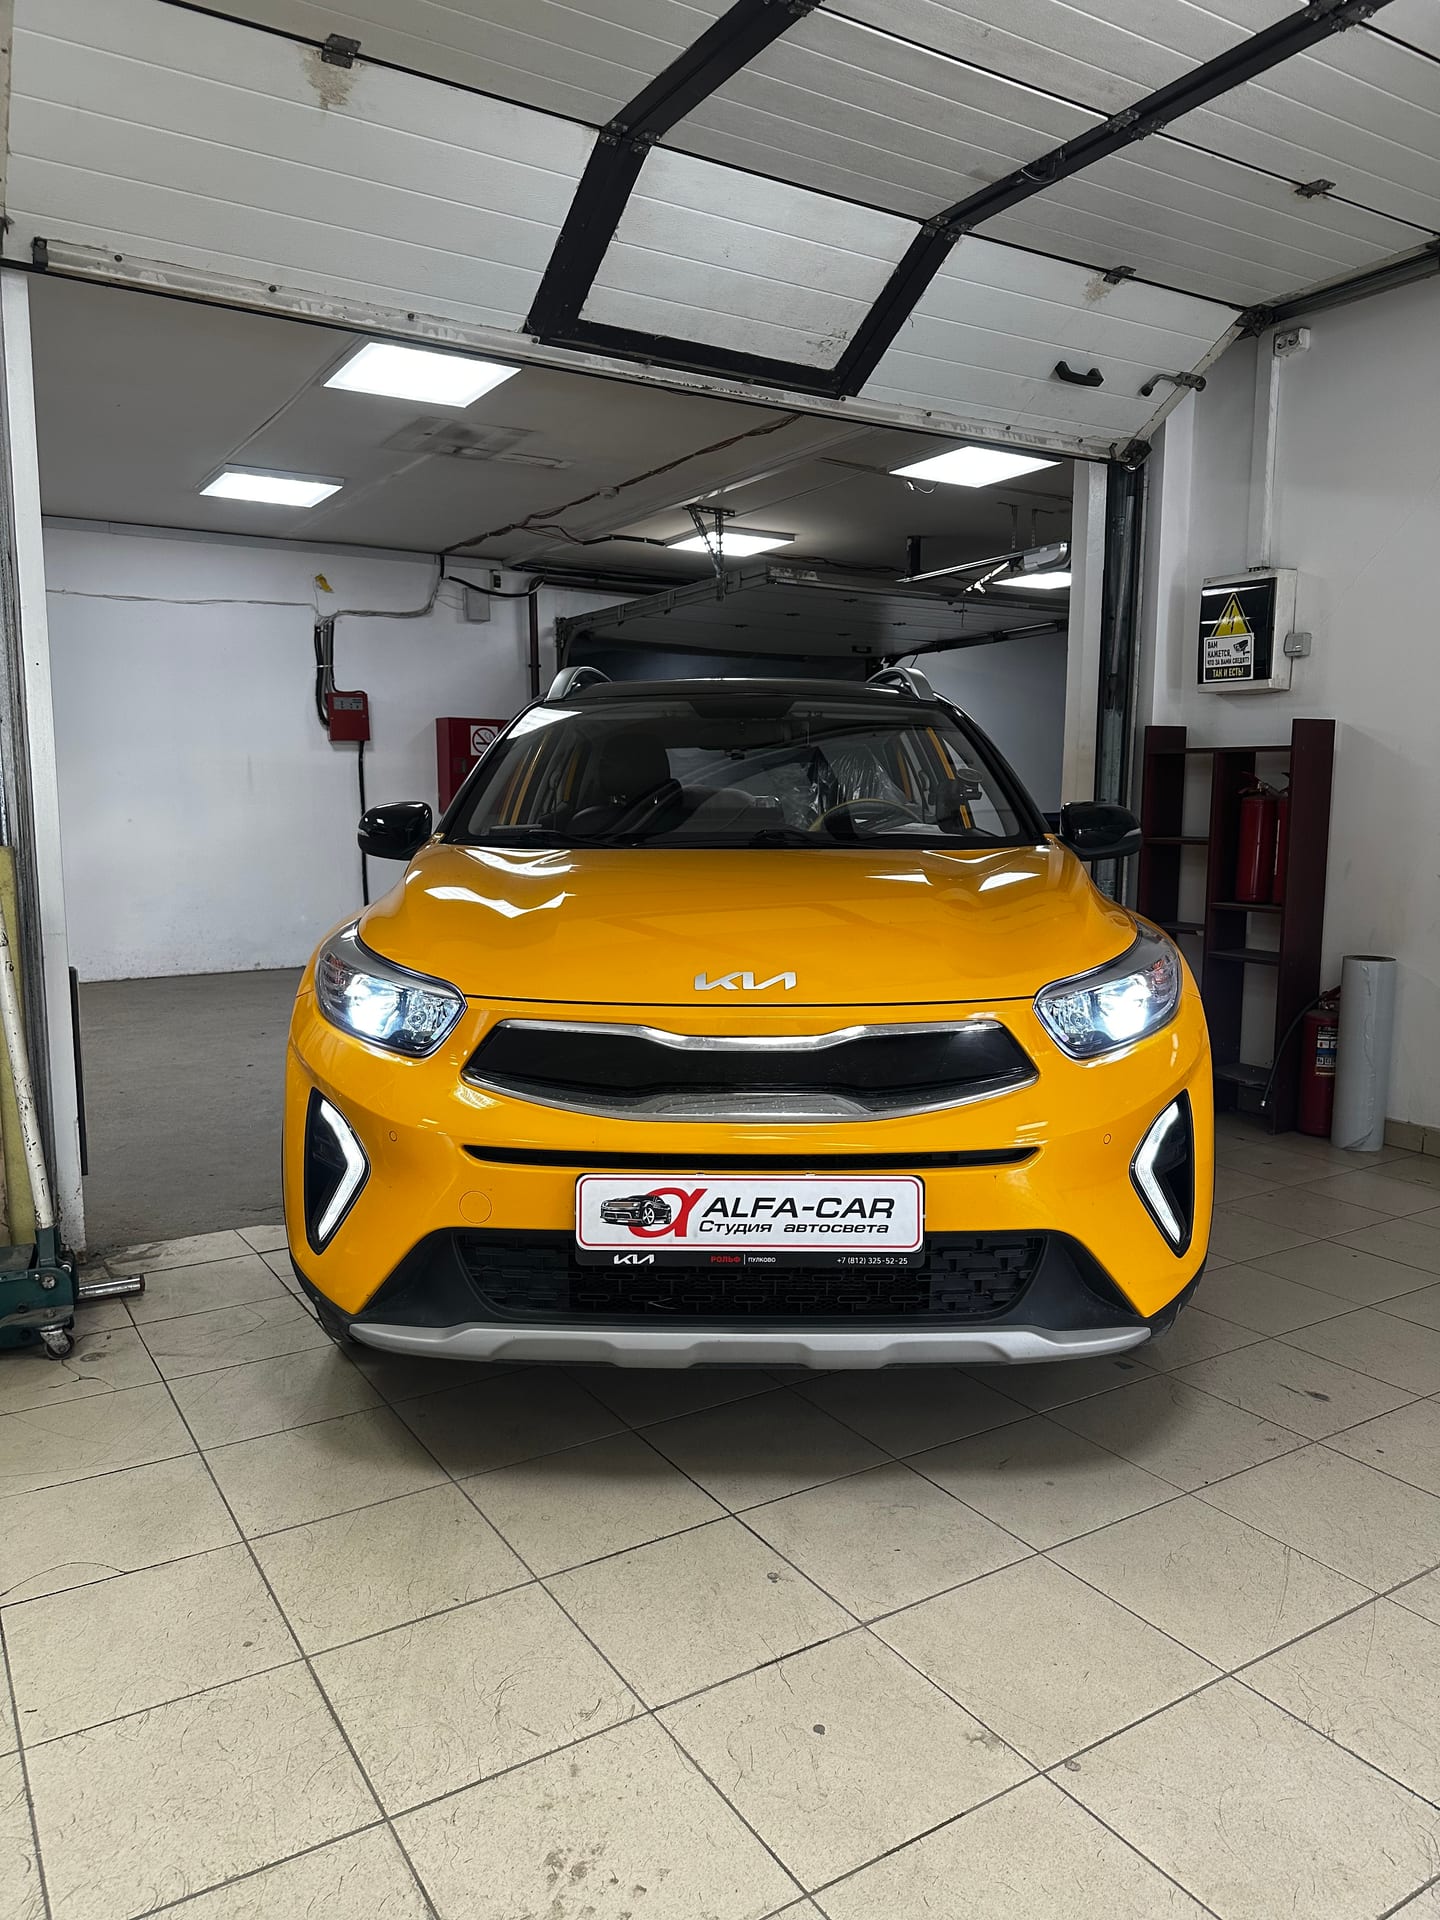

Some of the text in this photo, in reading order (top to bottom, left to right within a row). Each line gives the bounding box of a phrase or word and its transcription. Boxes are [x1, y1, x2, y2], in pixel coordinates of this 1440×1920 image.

[1208, 641, 1218, 649] ВАМ
[1213, 667, 1244, 678] ТАК И ЕСТЬ!
[694, 971, 797, 991] KIA
[701, 1196, 895, 1219] ALFA-CAR
[699, 1220, 889, 1236] Студия автосвета
[710, 1255, 741, 1264] РОЛЬФ
[837, 1256, 908, 1265] +7 (812) 325-52-25
